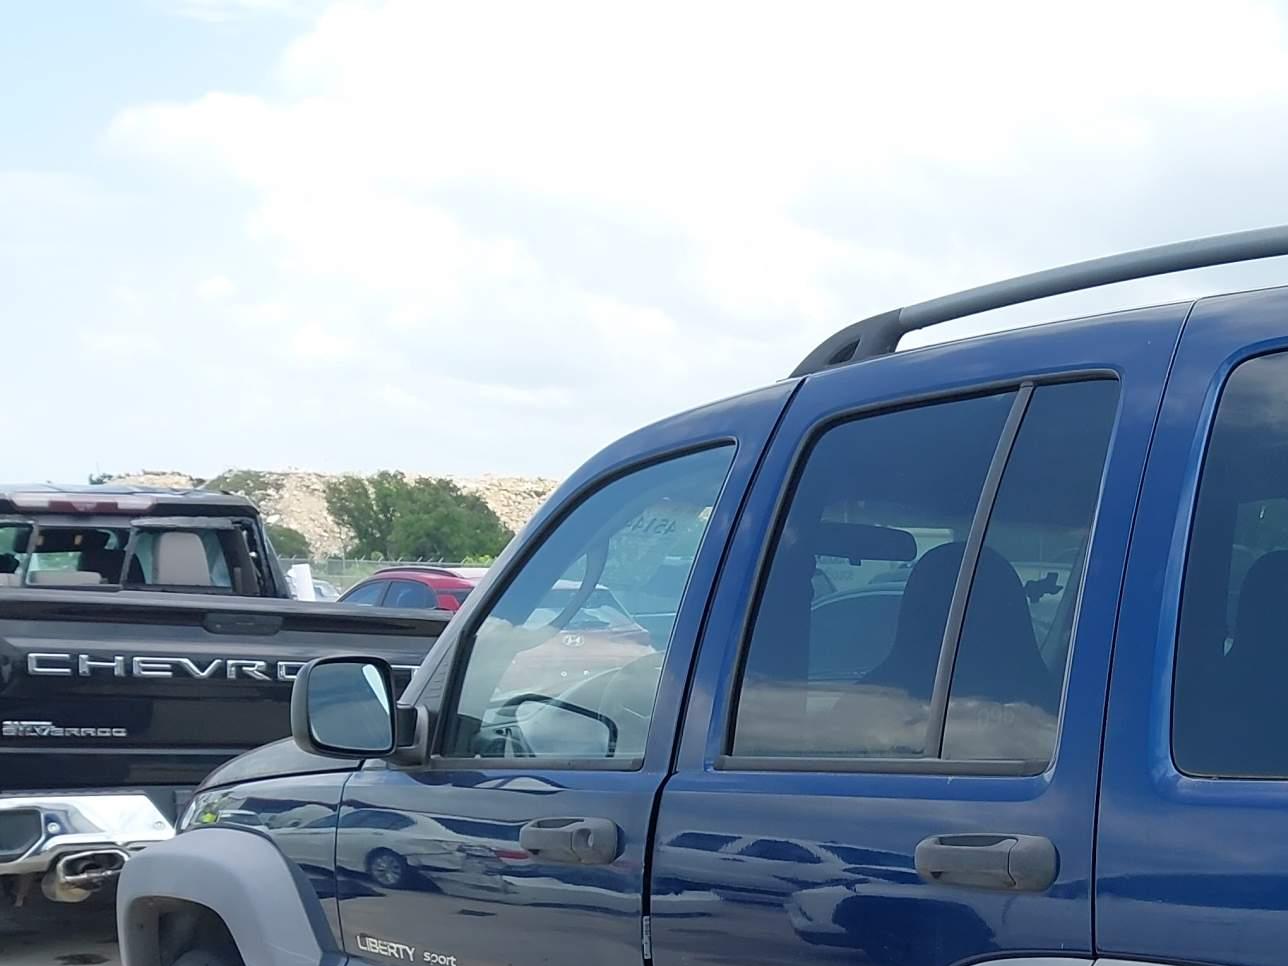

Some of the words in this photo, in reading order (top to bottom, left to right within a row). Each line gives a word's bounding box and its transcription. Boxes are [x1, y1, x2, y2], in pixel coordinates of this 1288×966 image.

[27, 652, 420, 682] CHEVRO
[356, 935, 416, 962] LIBERTY
[423, 951, 457, 966] sport
